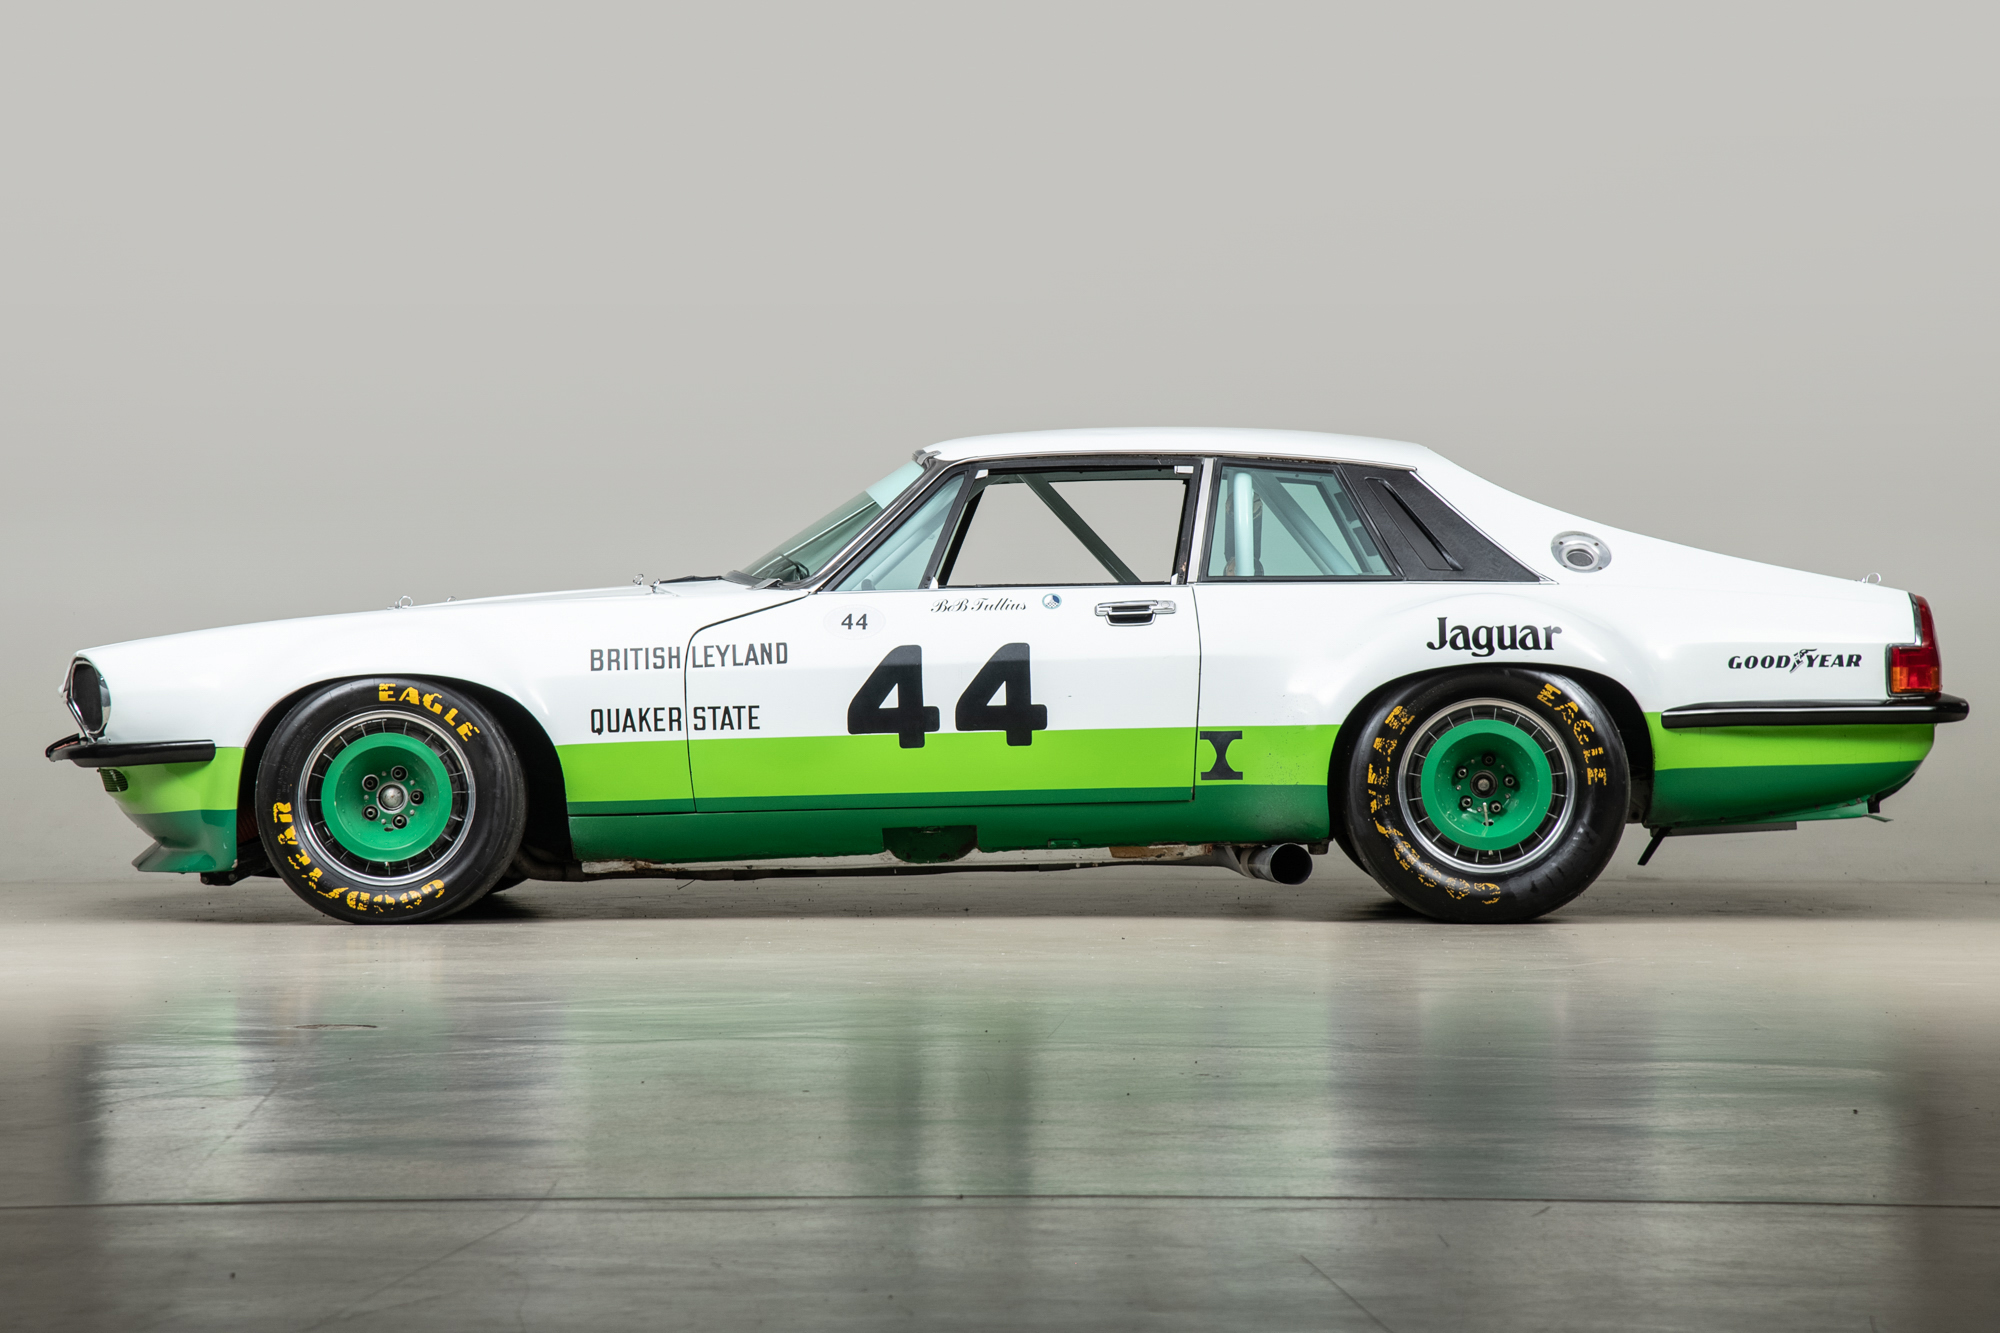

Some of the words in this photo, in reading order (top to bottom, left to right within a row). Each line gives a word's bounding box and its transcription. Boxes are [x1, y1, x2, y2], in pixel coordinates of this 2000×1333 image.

[841, 613, 868, 630] 44
[1426, 617, 1562, 657] Jaguar
[590, 647, 682, 672] BRITISH
[693, 641, 788, 668] LEYLAND
[378, 683, 481, 742] EAGLE
[847, 642, 1047, 749] 44
[590, 707, 682, 736] QUAKER
[694, 705, 760, 731] STATE
